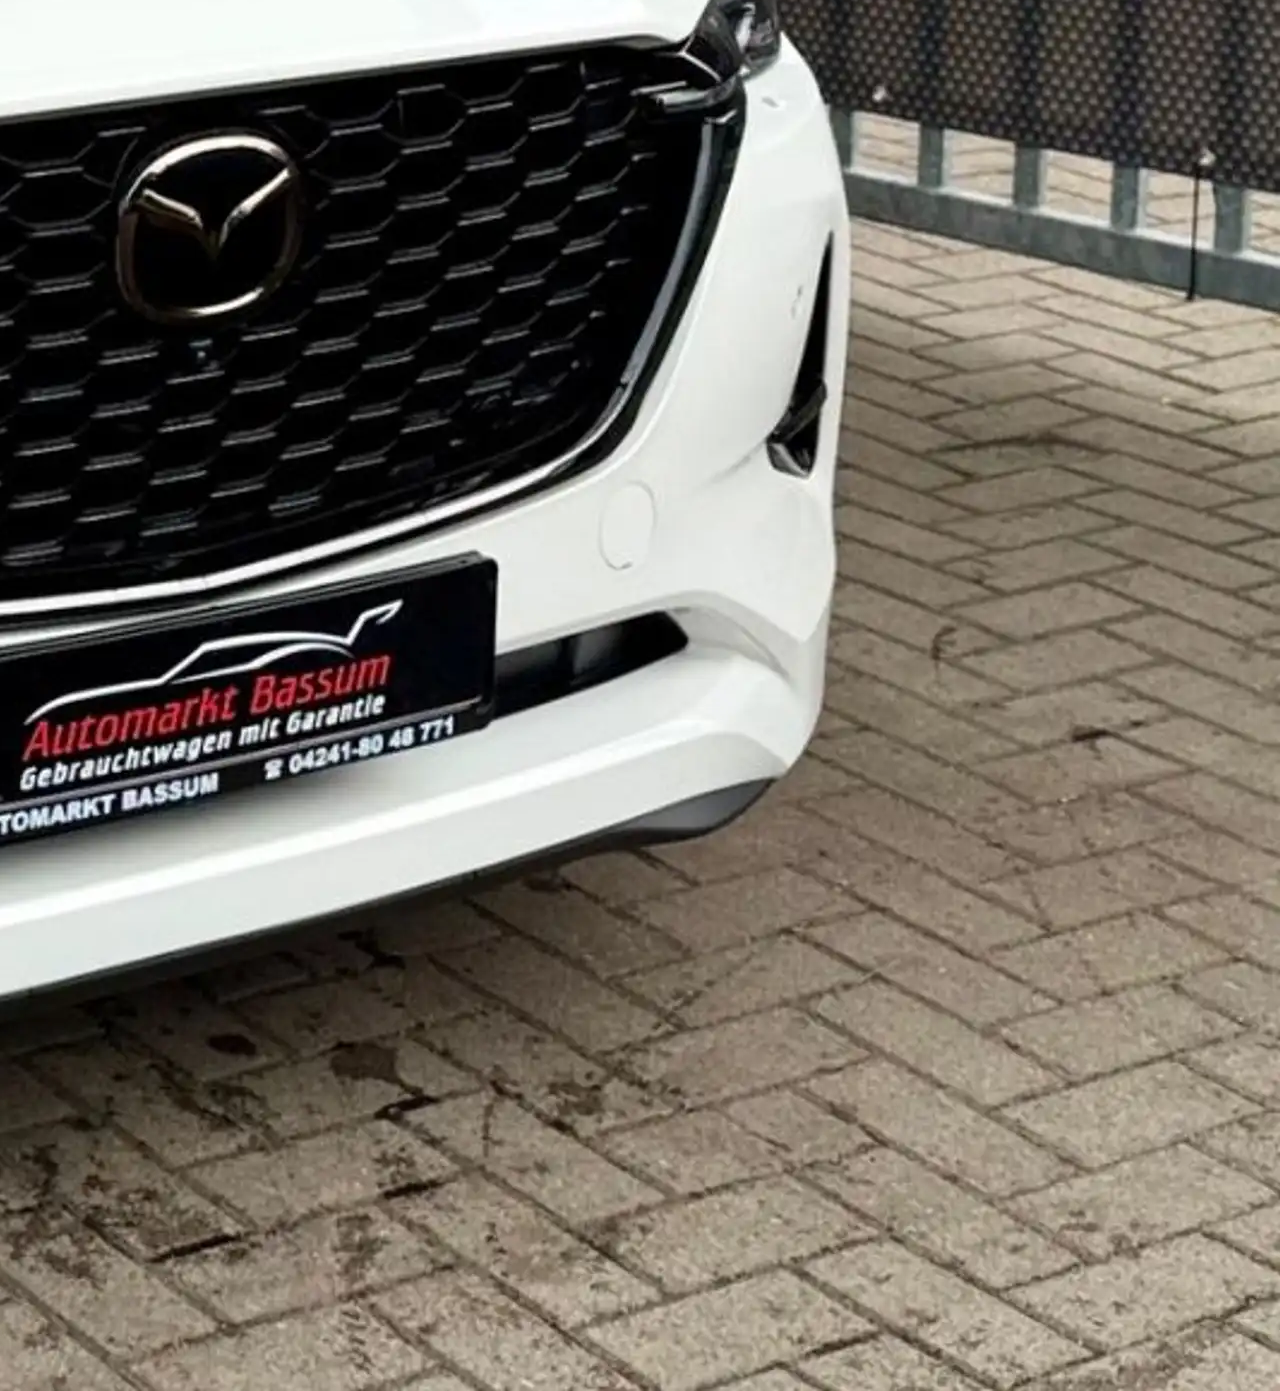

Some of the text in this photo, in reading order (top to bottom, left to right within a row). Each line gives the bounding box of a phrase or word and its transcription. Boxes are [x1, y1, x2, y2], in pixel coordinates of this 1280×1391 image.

[19, 693, 387, 792] Gebrauchtwagen mit Garantie
[22, 654, 391, 762] Automarkt Bassum
[288, 734, 384, 775] 04241-80
[419, 714, 455, 742] 771
[120, 771, 220, 810] BASSUM
